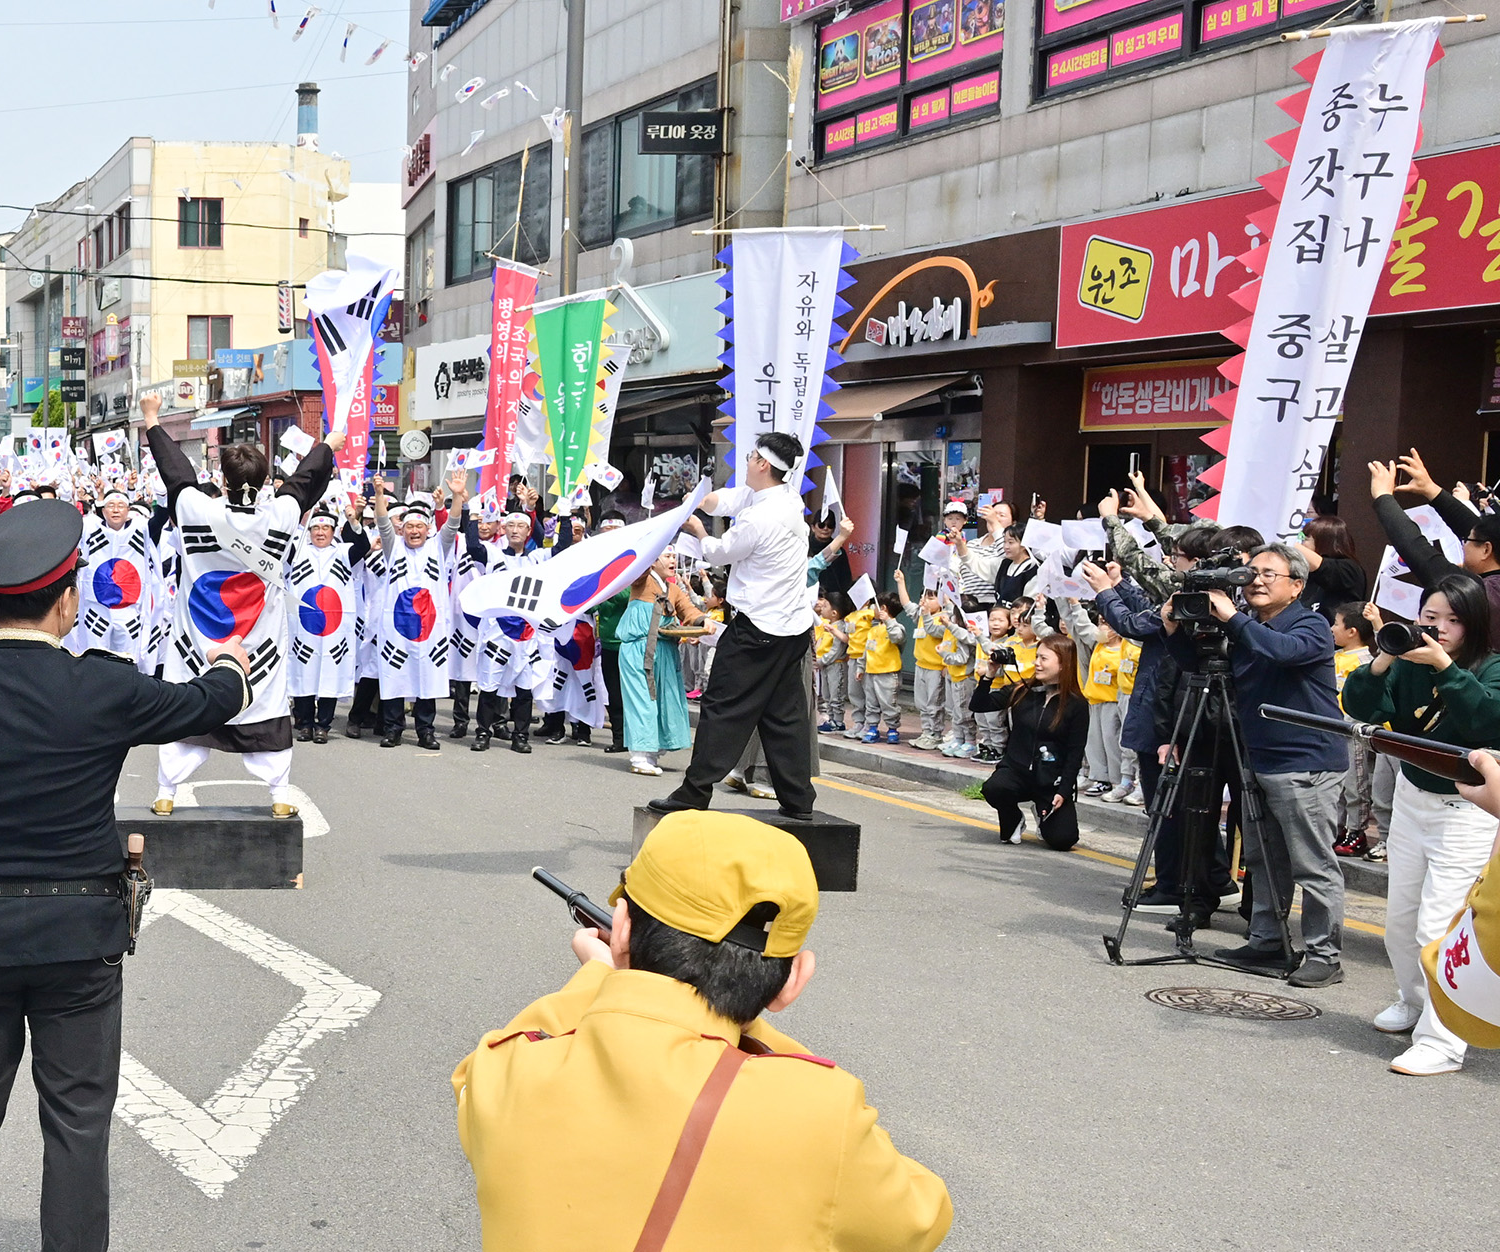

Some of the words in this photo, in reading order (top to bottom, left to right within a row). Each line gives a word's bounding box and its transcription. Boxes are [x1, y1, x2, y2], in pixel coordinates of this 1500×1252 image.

[1114, 23, 1180, 56] 여성고객우대
[646, 124, 687, 140] 루디아
[689, 124, 717, 140] 옷장
[1287, 83, 1358, 265] 종갓집
[1343, 84, 1409, 268] 누구나
[794, 271, 820, 342] 자유와
[1088, 257, 1141, 305] 원조
[217, 353, 233, 363] 남성
[496, 298, 513, 363] 병영의
[791, 352, 811, 421] 독립을
[1257, 314, 1312, 423] 중구
[1303, 315, 1361, 423] 살고
